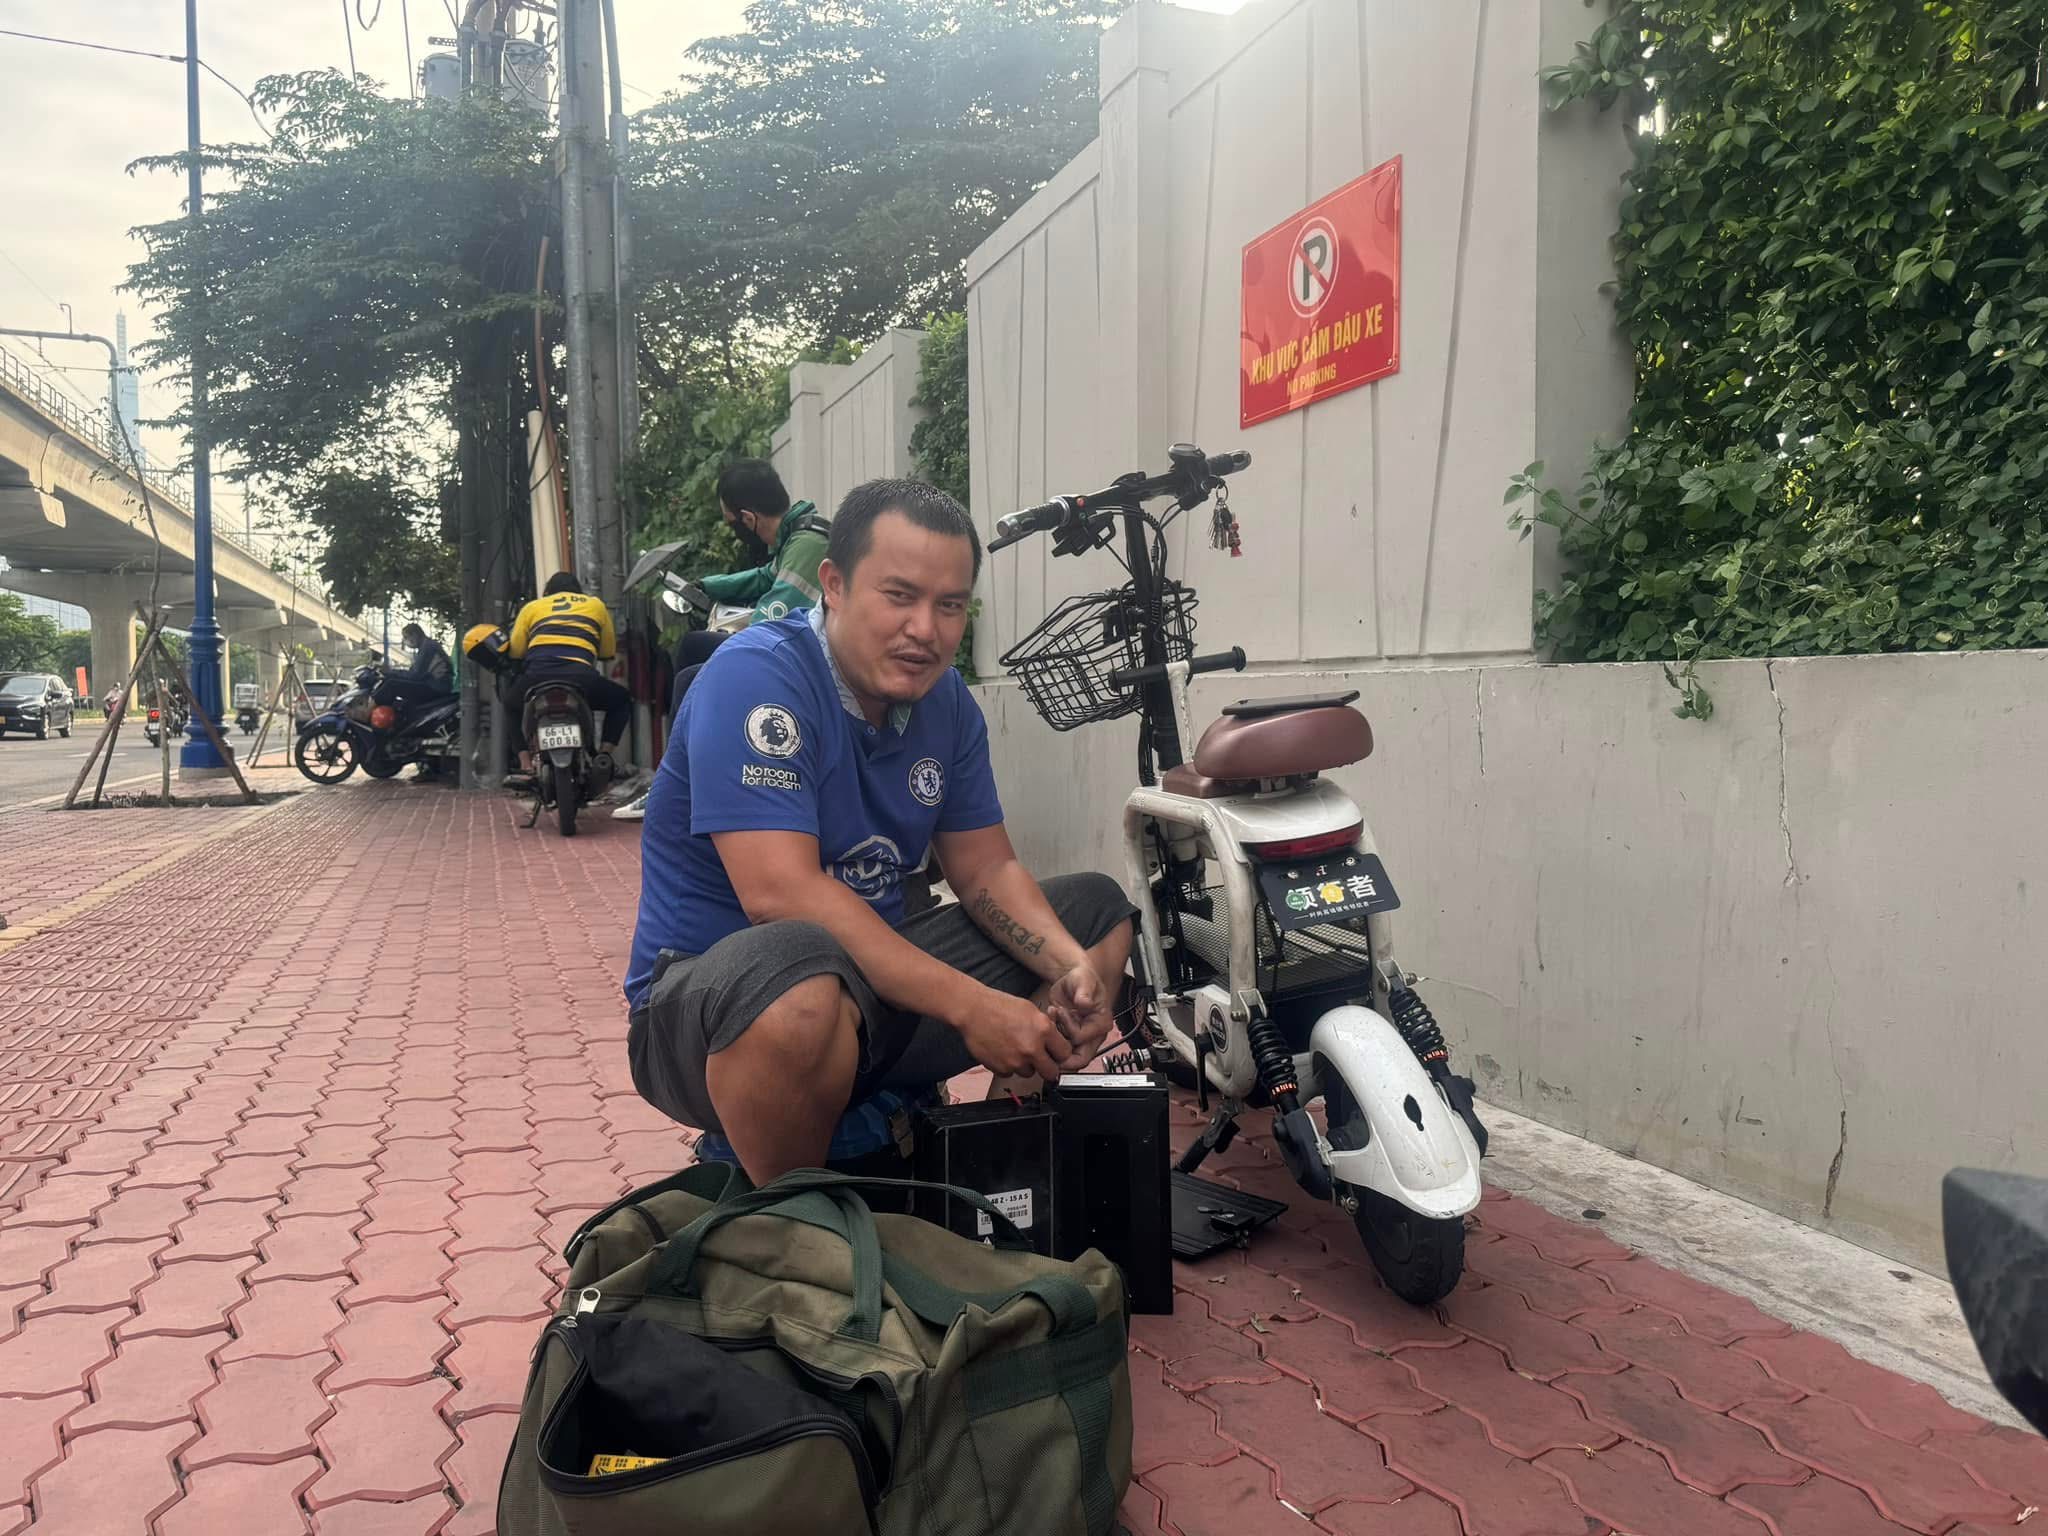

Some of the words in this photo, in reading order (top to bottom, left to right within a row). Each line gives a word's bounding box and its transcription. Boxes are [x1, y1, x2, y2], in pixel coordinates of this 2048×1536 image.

[1249, 351, 1274, 387] KHU
[1364, 303, 1383, 339] XE
[1299, 362, 1337, 392] PARKING
[743, 764, 763, 776] No
[764, 767, 797, 781] room
[913, 761, 937, 776] CHELSEA
[742, 775, 761, 785] for
[763, 777, 801, 791] racism
[1286, 875, 1376, 911] 领者
